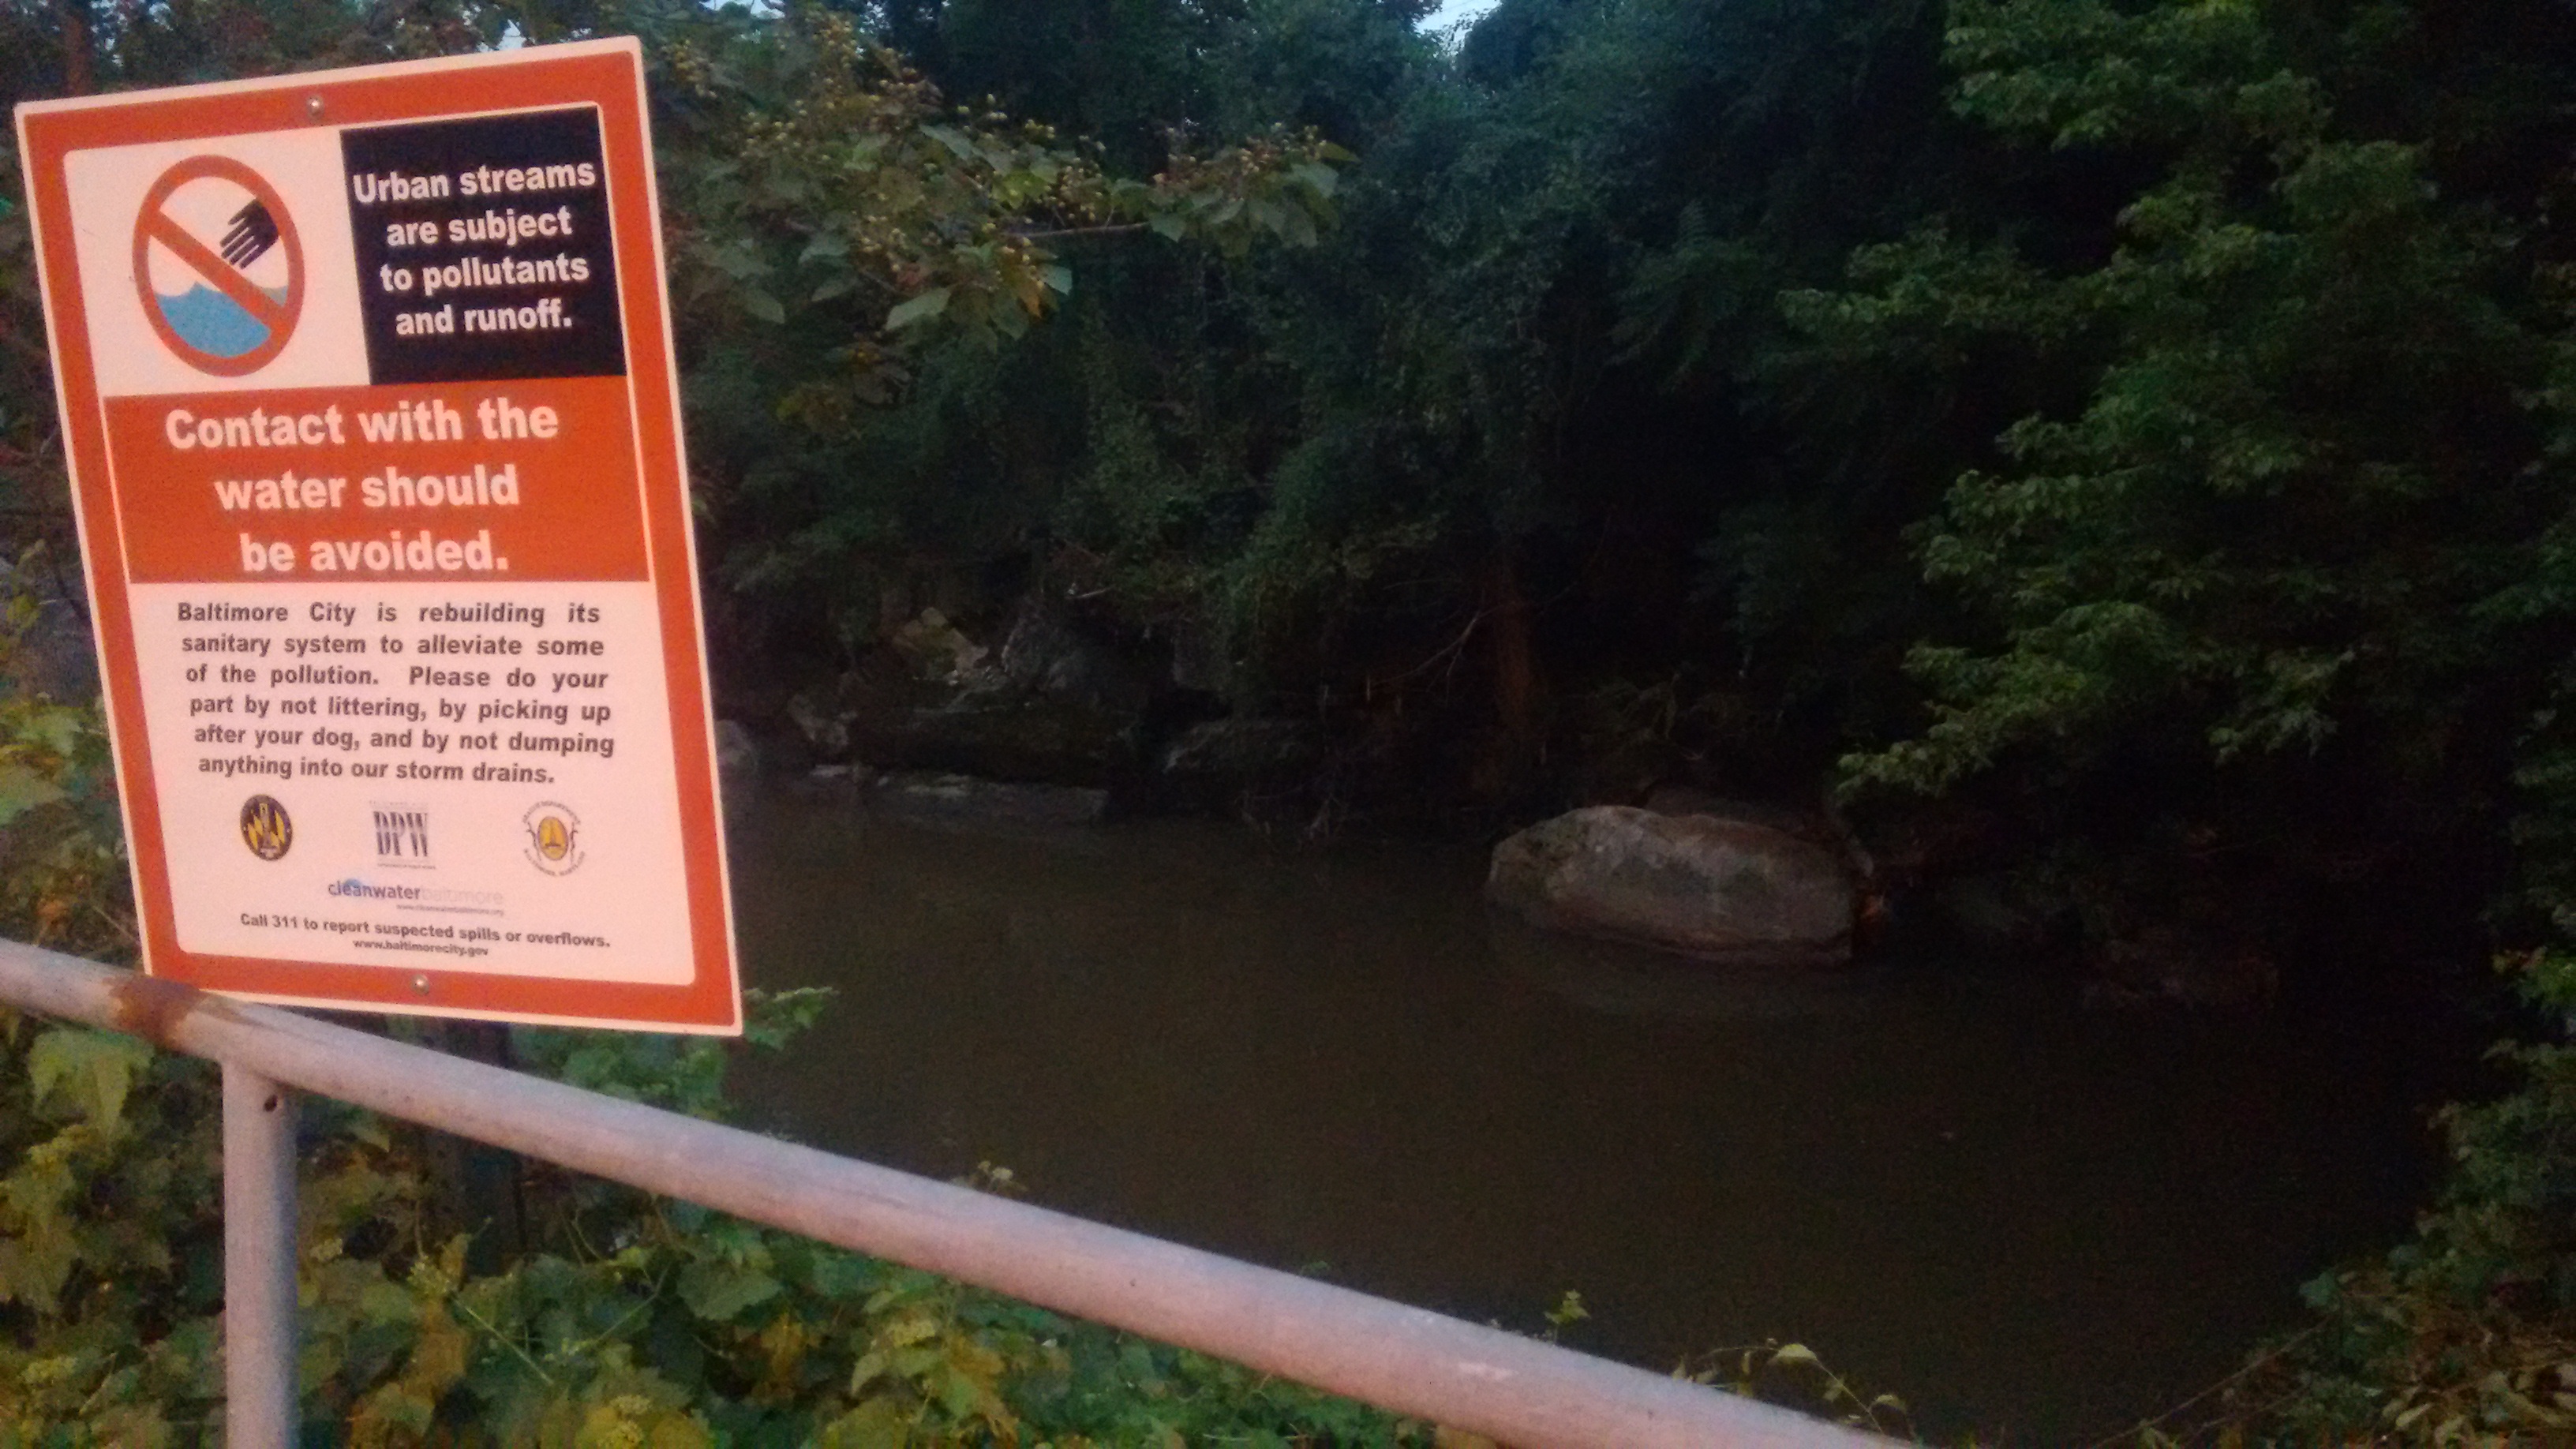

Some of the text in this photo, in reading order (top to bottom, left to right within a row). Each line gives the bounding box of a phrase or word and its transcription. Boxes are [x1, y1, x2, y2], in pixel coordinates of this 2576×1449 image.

[354, 162, 597, 203] Urban streams
[387, 205, 573, 246] are subject
[380, 253, 590, 296] to pollutants
[396, 298, 572, 335] and runoff.
[165, 397, 559, 448] Contact with the
[214, 464, 519, 510] water should
[239, 530, 509, 572] be avoided.
[178, 601, 600, 627] Baltimore City is rebuilding its
[182, 634, 605, 658] sanitary system to alleviate some
[185, 663, 608, 693] of the pollution. Please do your
[190, 695, 611, 724] part by not littering, by picking up
[194, 724, 614, 758] after your dog, and by not dumping
[199, 756, 554, 783] anything into our storm drains.
[373, 811, 428, 856] DPW
[241, 913, 610, 947] Call 311 to report suspected spills or overflows.
[353, 940, 489, 957] www.baltimorecity.gov
